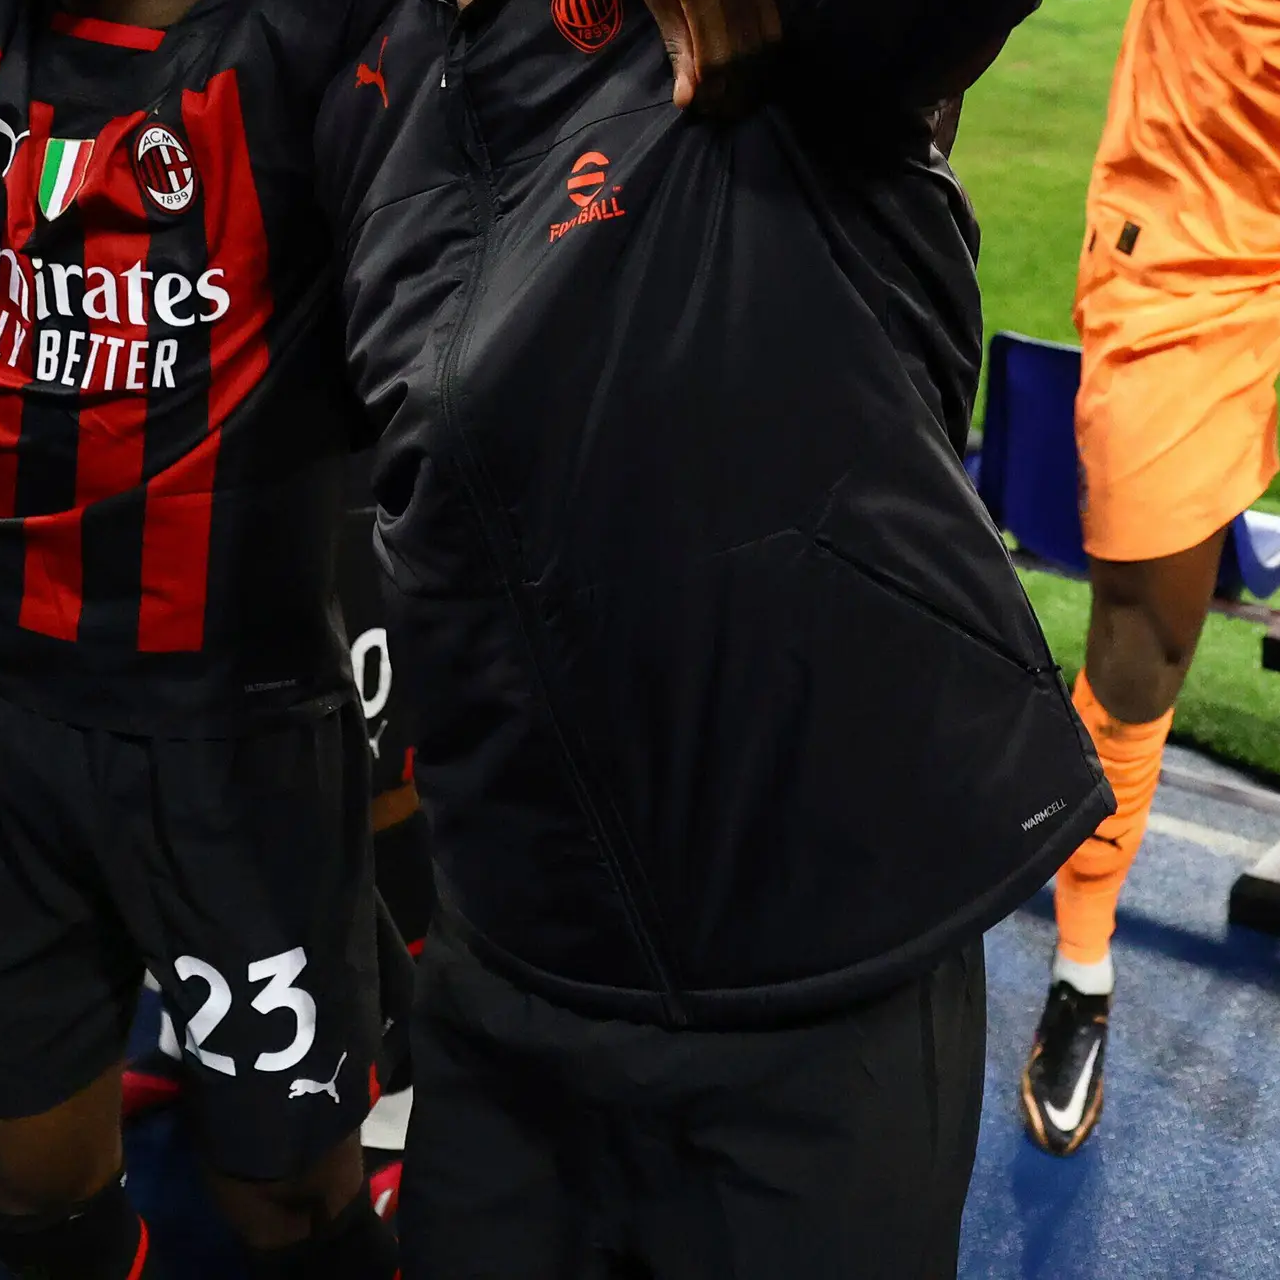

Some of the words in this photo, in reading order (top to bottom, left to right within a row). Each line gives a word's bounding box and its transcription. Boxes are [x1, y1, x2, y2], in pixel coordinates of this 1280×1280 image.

[142, 131, 175, 150] ACM
[160, 191, 189, 204] 1899
[36, 329, 179, 391] BETTER
[1021, 798, 1067, 831] WARMCELL
[174, 946, 317, 1077] 23
